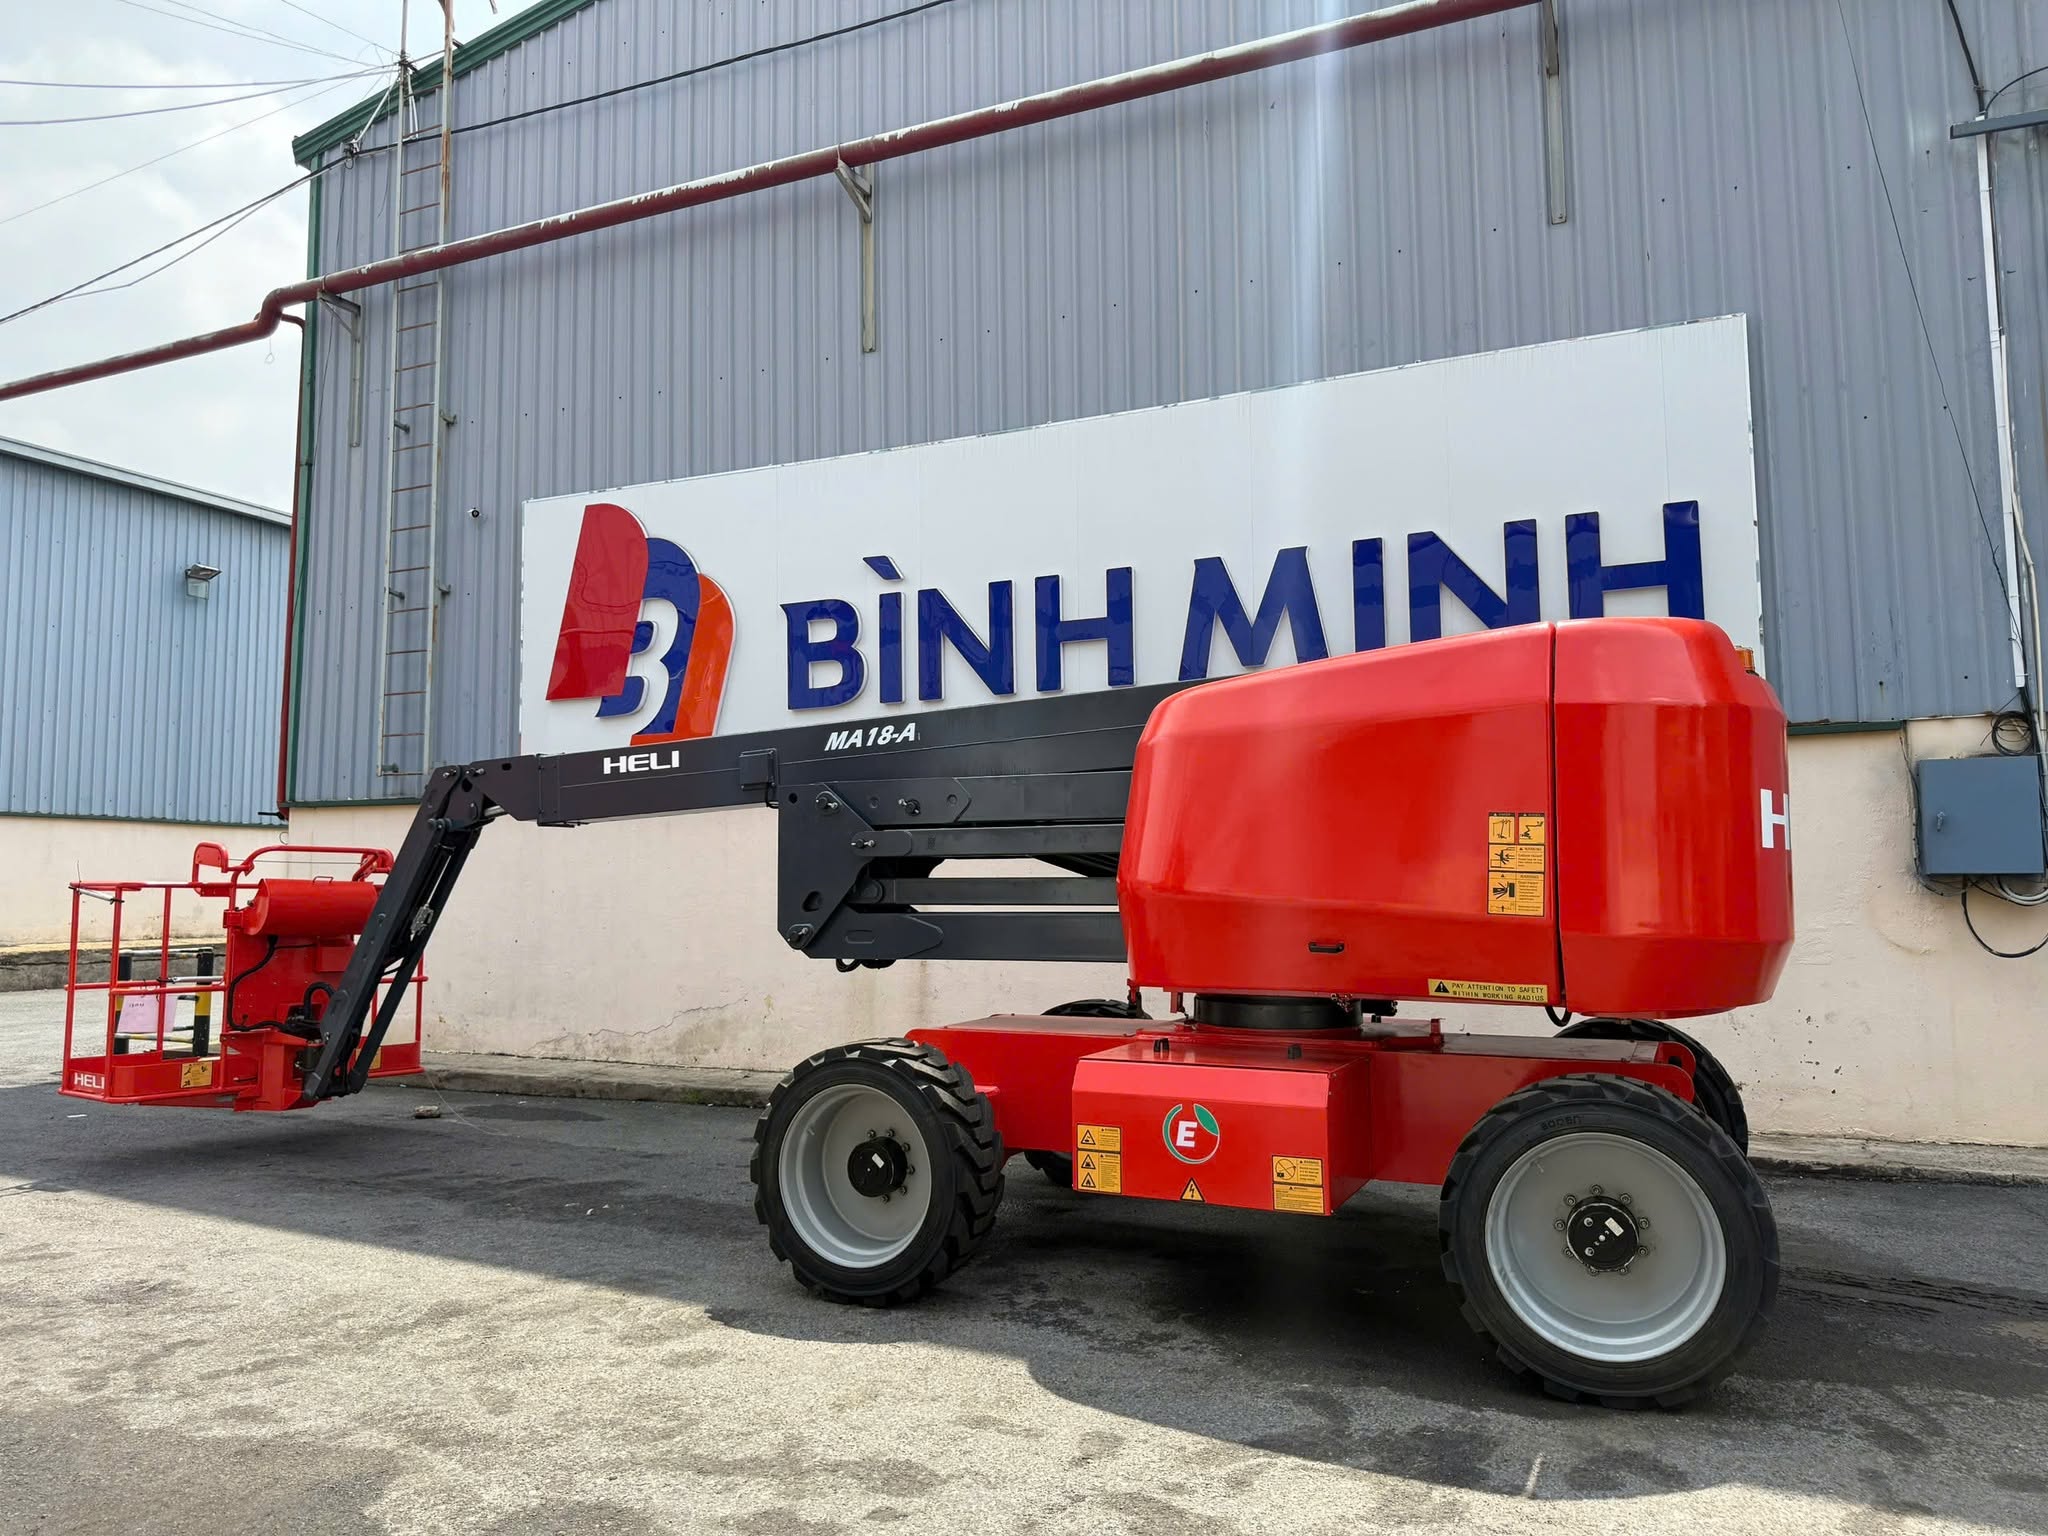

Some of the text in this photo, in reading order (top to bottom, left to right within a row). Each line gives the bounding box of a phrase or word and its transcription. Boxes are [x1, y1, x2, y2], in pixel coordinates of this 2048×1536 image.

[780, 500, 1704, 711] BÌNH MINH
[603, 750, 679, 774] HELI
[1452, 990, 1479, 998] WITHIN
[1467, 983, 1504, 992] ATTENTION
[74, 1072, 105, 1090] HELI
[1175, 1120, 1198, 1148] E
